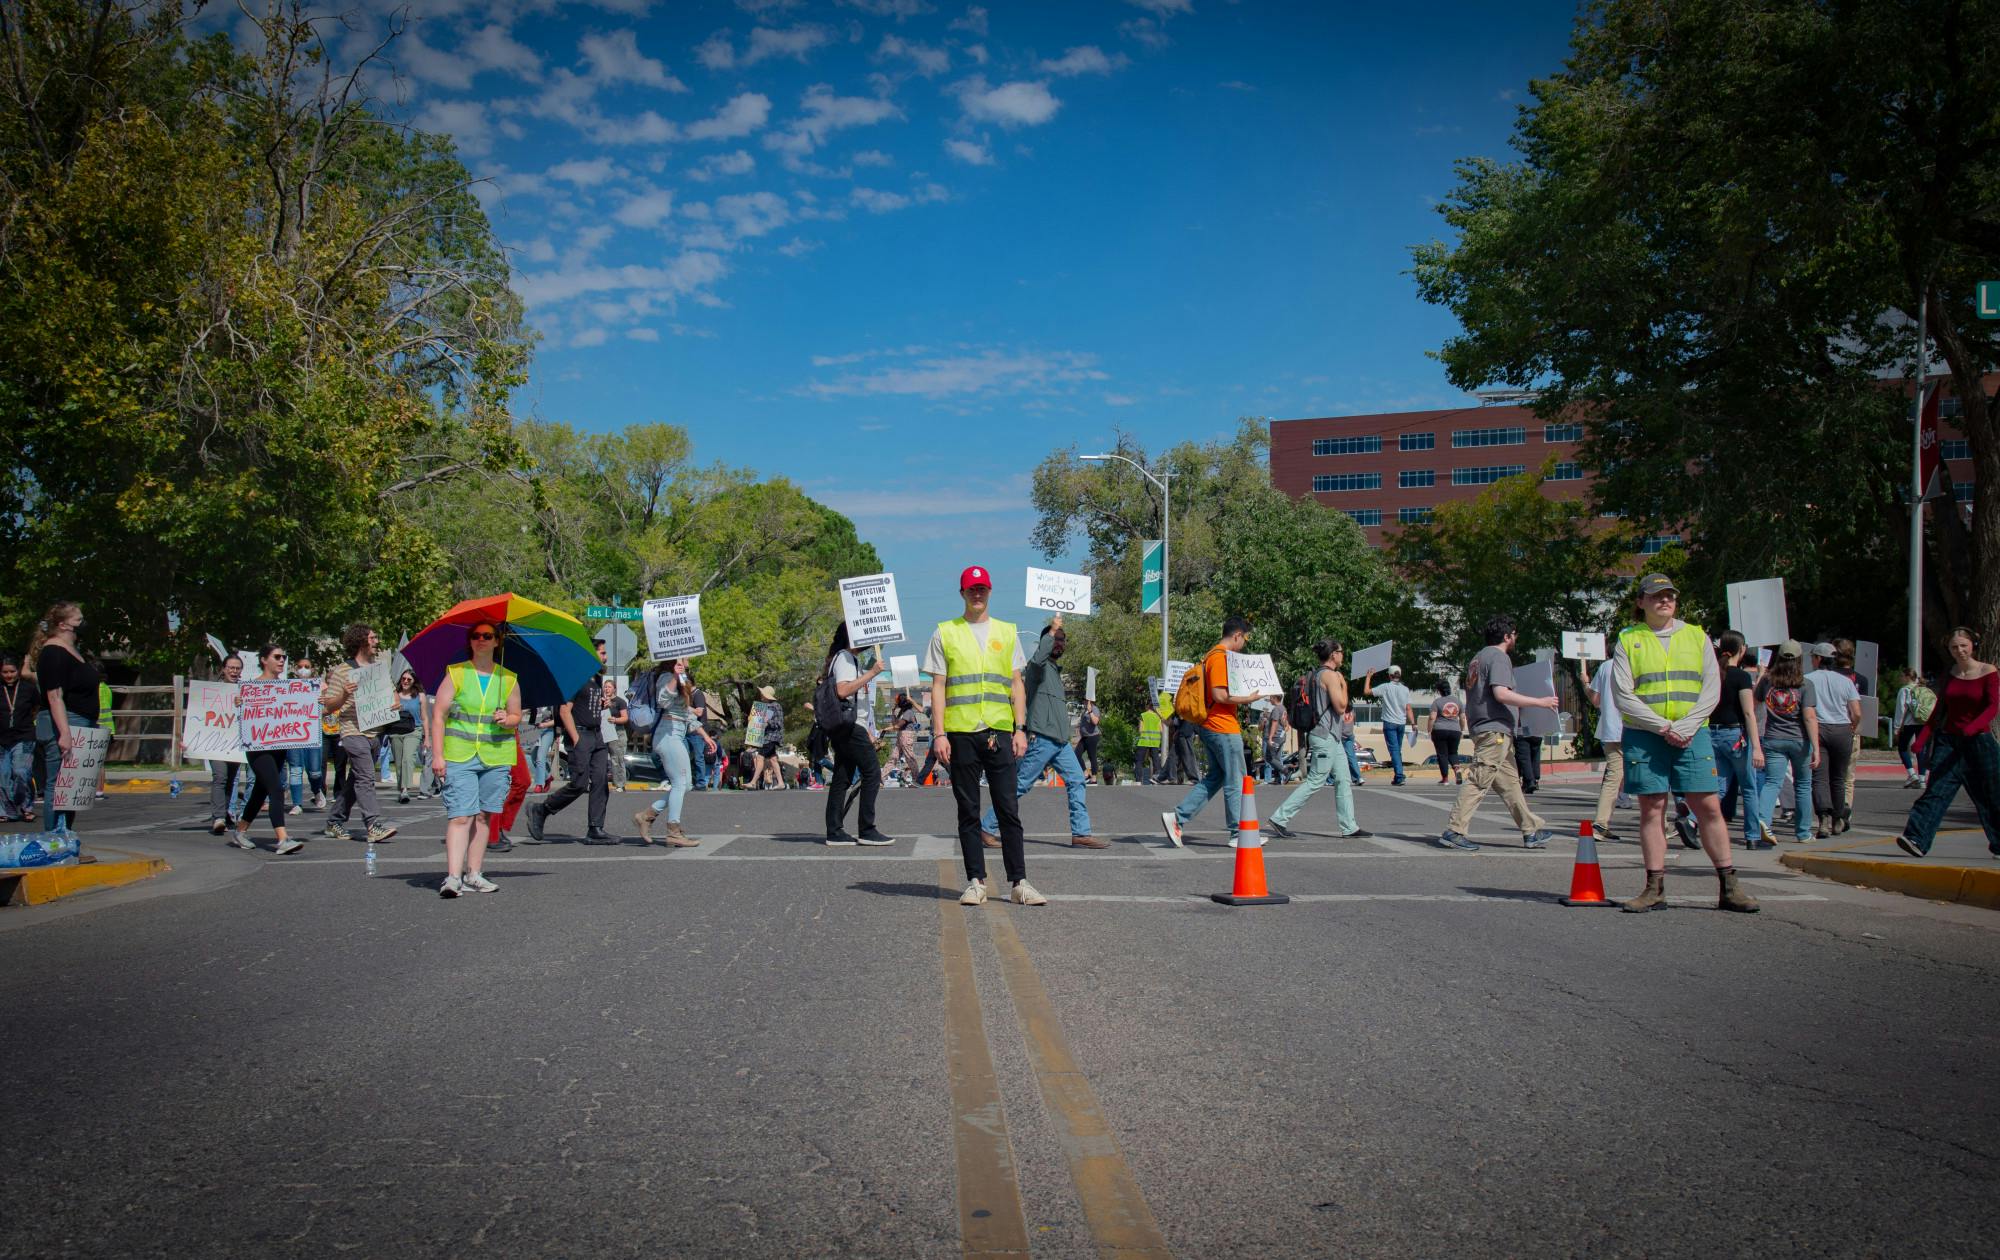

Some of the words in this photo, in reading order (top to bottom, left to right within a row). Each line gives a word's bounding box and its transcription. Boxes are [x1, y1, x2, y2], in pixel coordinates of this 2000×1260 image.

[1981, 284, 2000, 314] L
[851, 586, 886, 597] PROTECTING
[653, 600, 689, 610] PROTECTING
[857, 598, 869, 606] THE
[870, 596, 886, 605] PACK
[1039, 597, 1075, 611] FOOD
[587, 607, 602, 617] Las
[605, 607, 632, 619] Lomas
[658, 610, 669, 618] THE
[670, 608, 687, 616] PACK
[859, 605, 888, 616] INCLUDES
[659, 617, 688, 628] INCLUDES
[852, 614, 897, 627] INTERNATIONAL
[658, 626, 692, 639] DEPENDENT
[863, 624, 891, 635] WORKERS
[658, 636, 696, 649] HEALTHCARE
[1241, 658, 1265, 669] need
[240, 684, 275, 697] PROTECT
[275, 687, 287, 695] THE
[204, 710, 236, 729] PAY
[362, 707, 397, 727] WAGES
[251, 721, 313, 744] WORKERS
[63, 753, 80, 768] We
[82, 754, 95, 768] do
[56, 772, 75, 788] We
[54, 790, 69, 805] We
